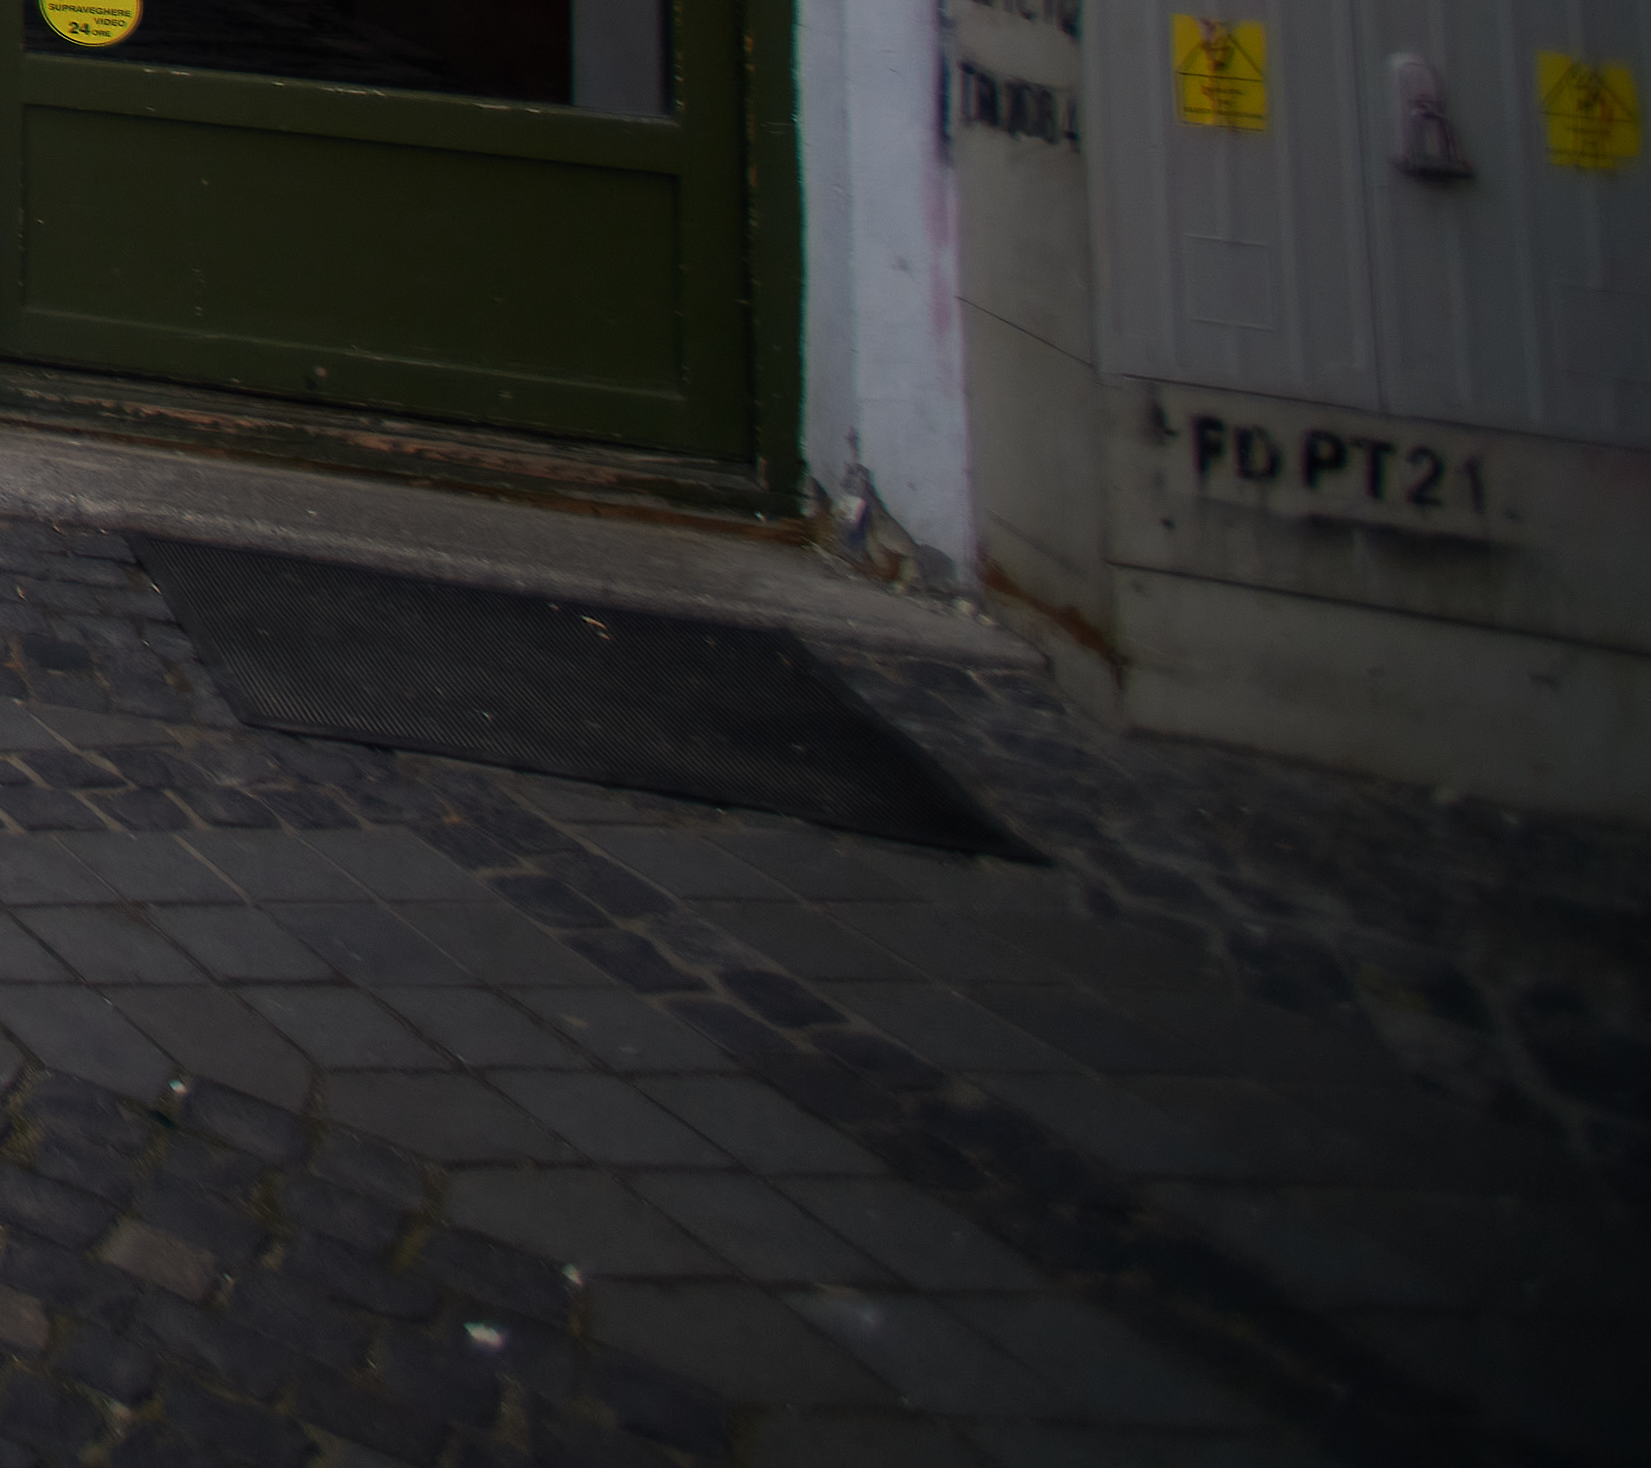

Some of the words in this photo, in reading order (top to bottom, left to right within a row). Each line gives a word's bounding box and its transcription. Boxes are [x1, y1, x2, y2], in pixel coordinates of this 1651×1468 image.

[48, 3, 133, 18] SUPRAVEGHERE
[68, 21, 90, 35] 24
[91, 28, 112, 38] ORE
[94, 17, 127, 28] VIDEO
